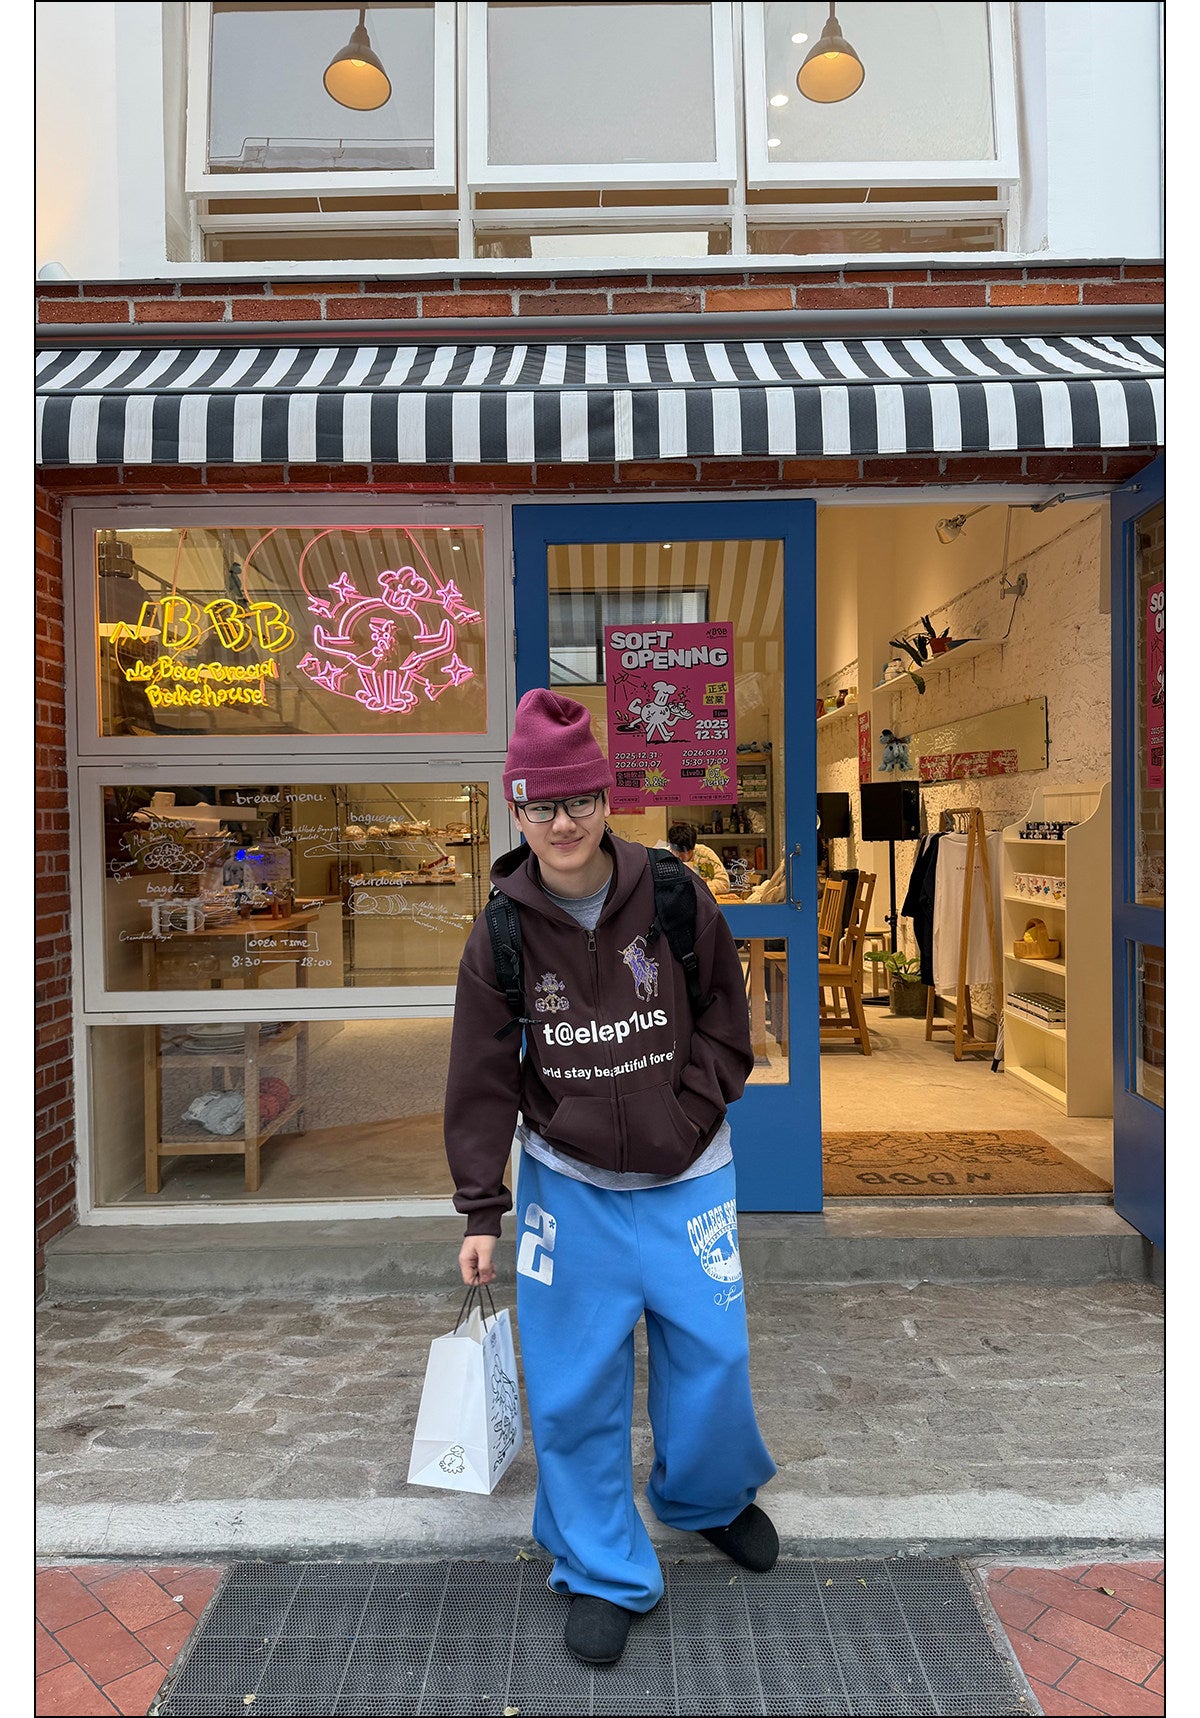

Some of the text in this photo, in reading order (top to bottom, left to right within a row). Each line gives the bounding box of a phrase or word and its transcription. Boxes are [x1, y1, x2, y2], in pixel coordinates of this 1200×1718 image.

[610, 630, 673, 650] SOFT
[621, 645, 728, 670] OPENING
[126, 660, 153, 681] No
[207, 657, 277, 683] Bread
[707, 683, 728, 693] 正式
[145, 684, 265, 707] Bakehouse
[695, 719, 729, 729] 2025
[695, 729, 729, 740] 12.31
[682, 749, 728, 757] 2026.01.01
[615, 760, 661, 769] 2026.01.07
[703, 777, 730, 788] Teddy
[236, 792, 280, 804] bread
[150, 818, 197, 831] brioche
[348, 877, 413, 889] sourdough
[146, 882, 185, 897] bagels
[248, 939, 277, 948] OPEN
[232, 955, 333, 968] 8:30 18:00
[564, 1067, 592, 1080] stay
[687, 1204, 723, 1257] COLLEGE
